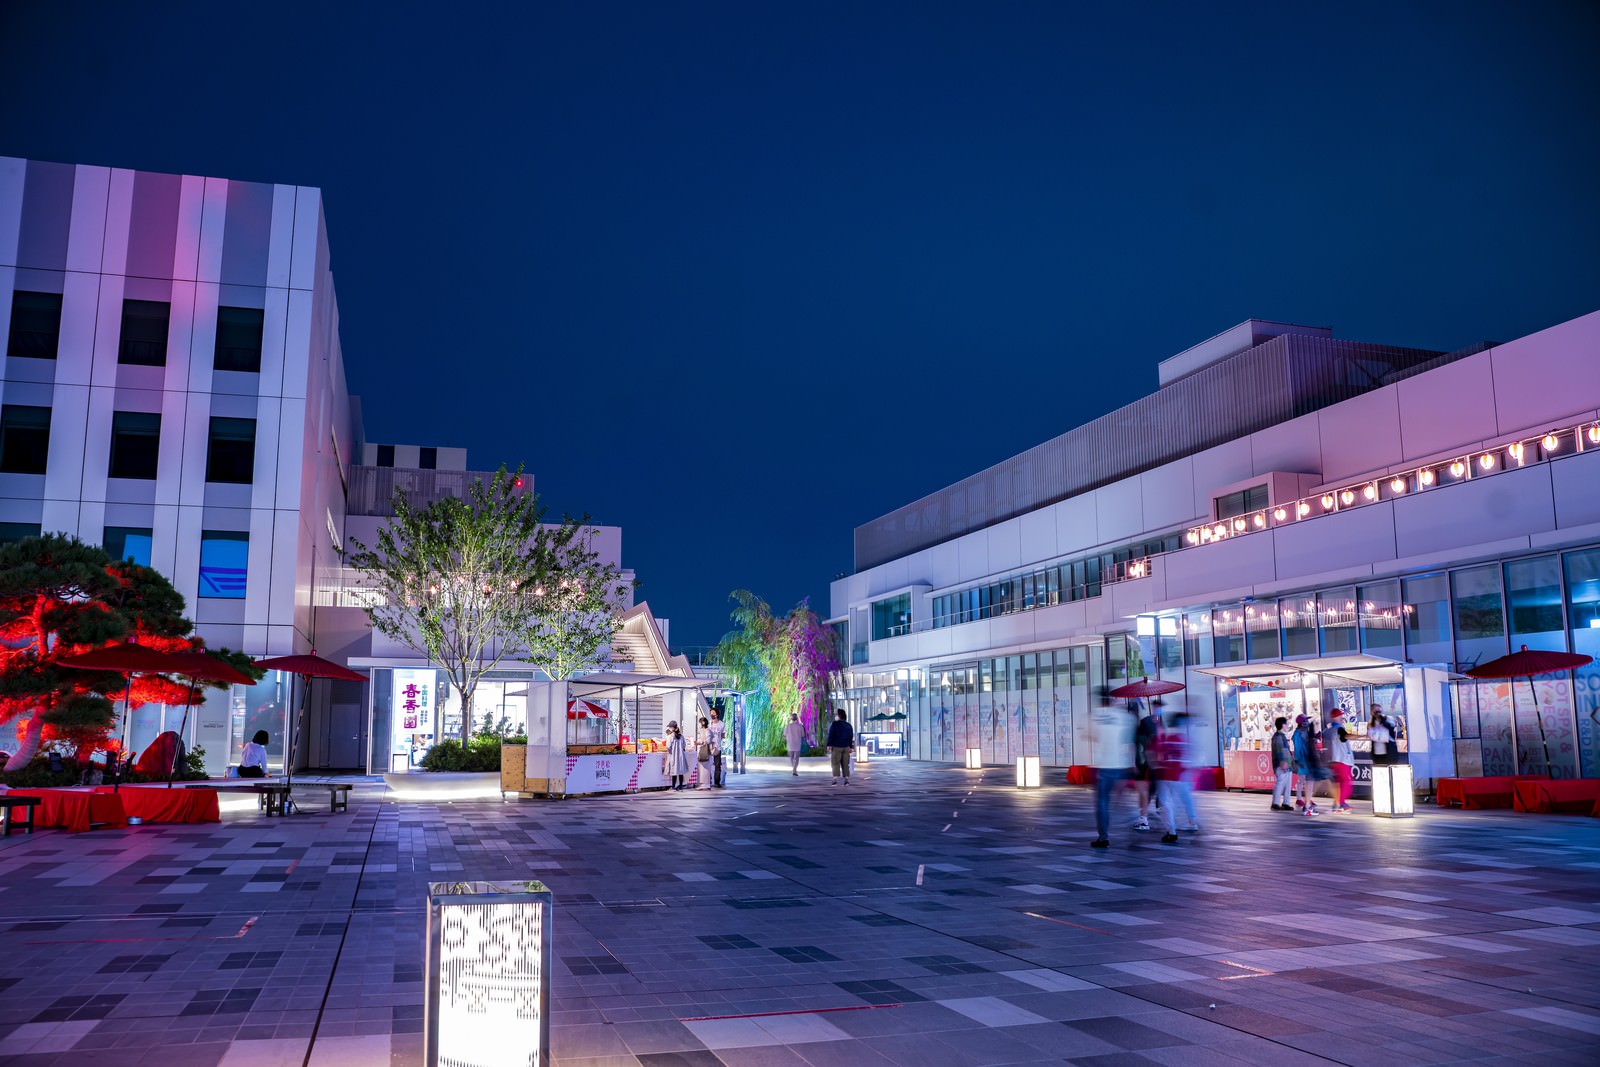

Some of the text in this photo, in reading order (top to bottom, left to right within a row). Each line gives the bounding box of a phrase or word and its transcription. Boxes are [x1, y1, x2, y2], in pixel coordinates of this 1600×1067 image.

[1553, 670, 1568, 703] OOT
[402, 684, 421, 729] 春香園
[1543, 706, 1557, 738] ECK
[1557, 708, 1570, 738] SPA
[596, 769, 610, 779] WORLD
[1484, 763, 1574, 779] ESENATION
[1582, 749, 1594, 776] BAS
